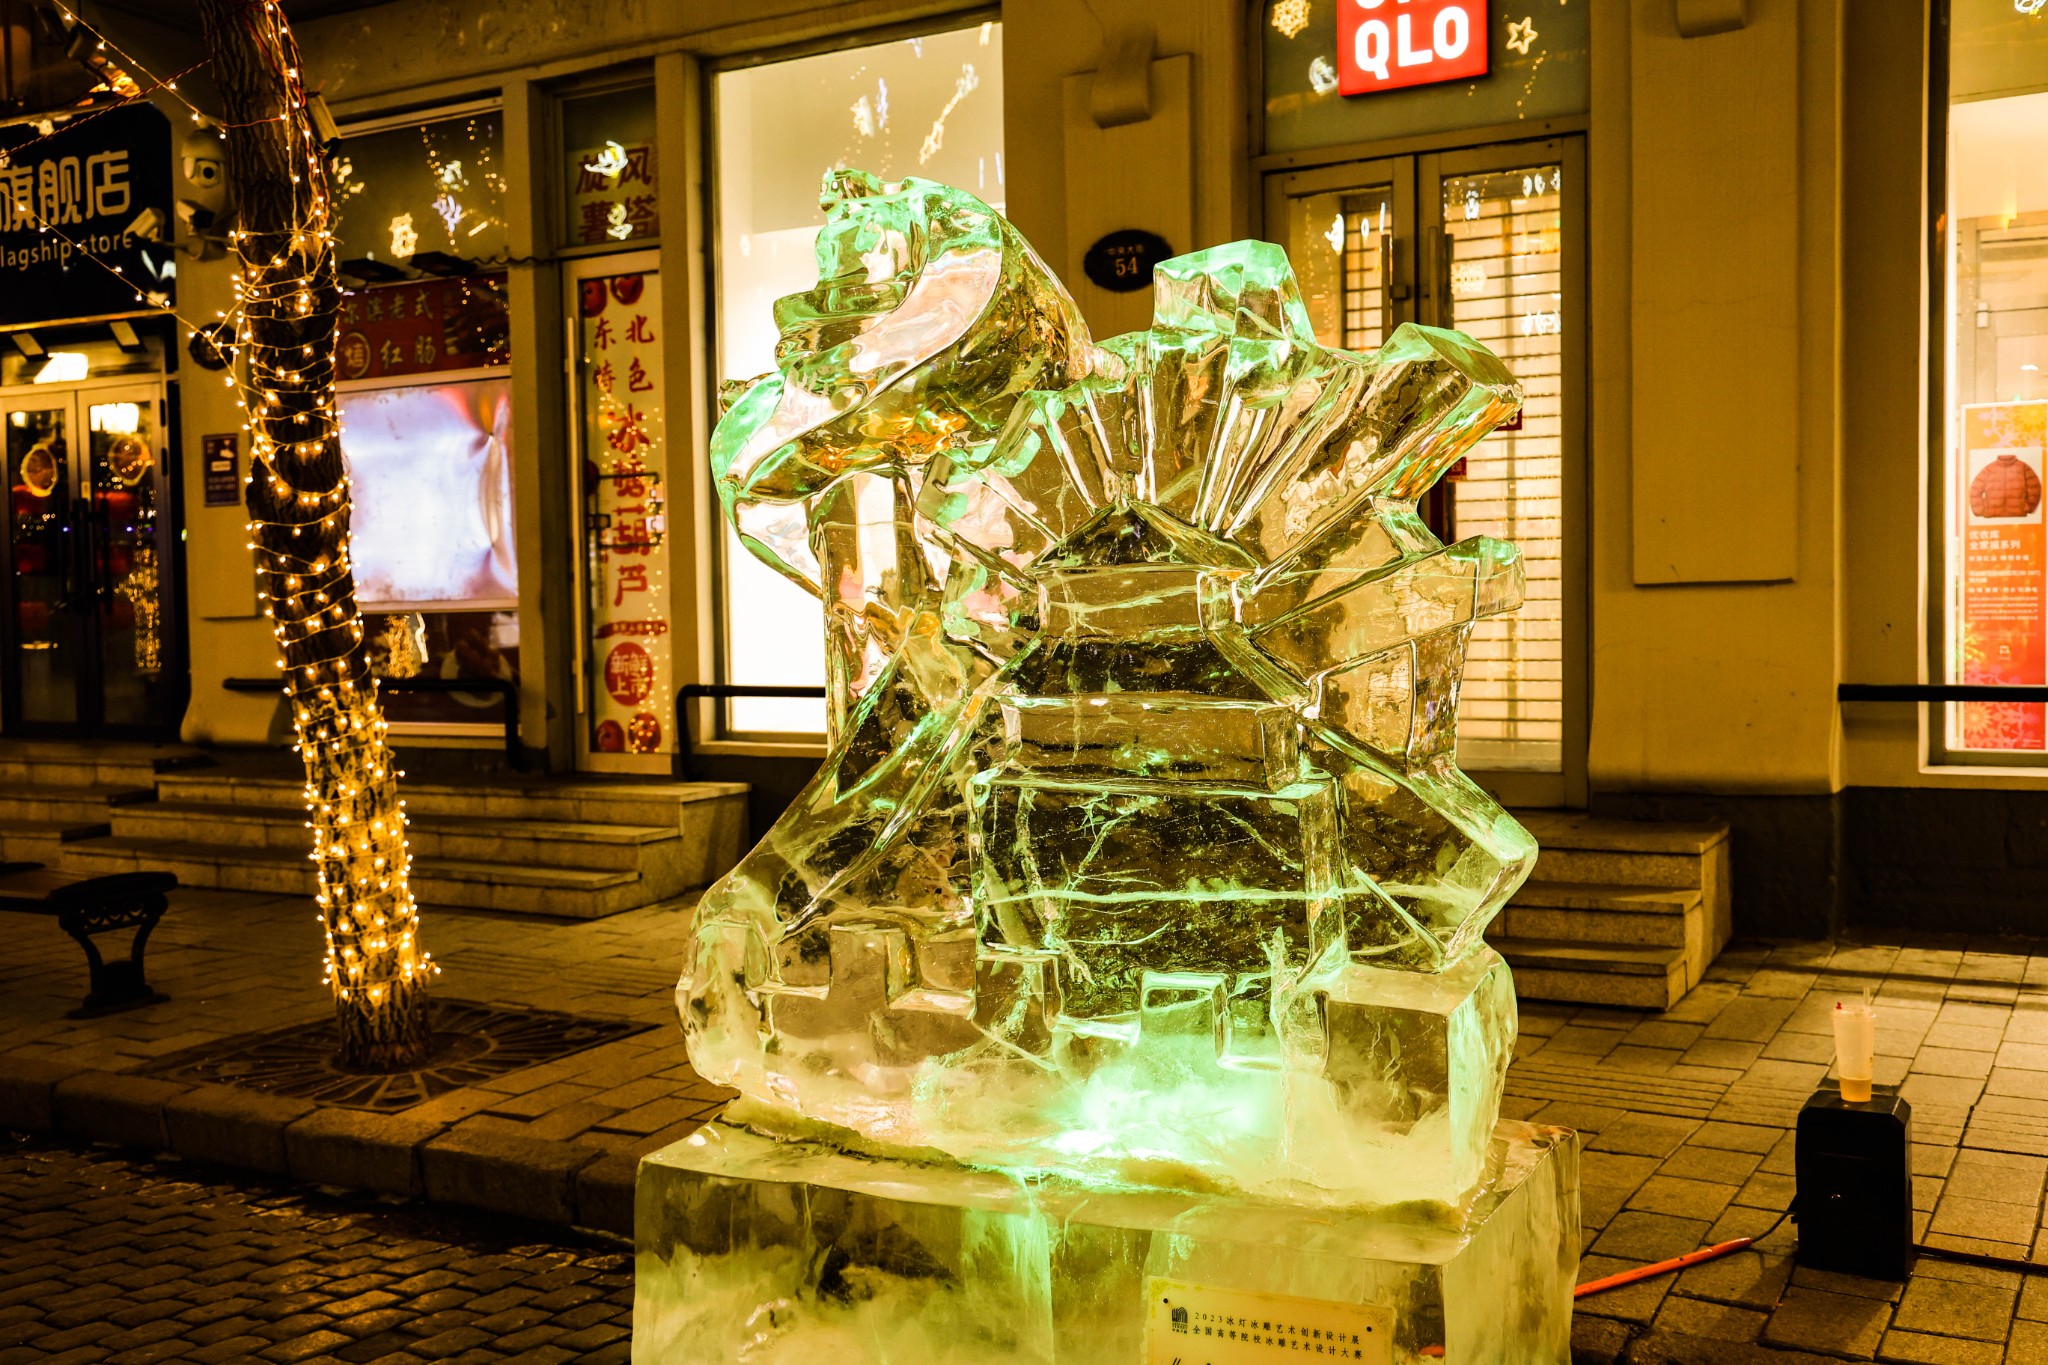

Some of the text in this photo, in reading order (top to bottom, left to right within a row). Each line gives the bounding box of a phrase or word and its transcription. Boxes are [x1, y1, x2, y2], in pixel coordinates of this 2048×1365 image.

[1355, 6, 1469, 80] QLO
[0, 150, 131, 233] 旗舰店
[80, 232, 133, 256] store
[1115, 256, 1139, 276] 54
[593, 313, 656, 351] 东北
[592, 356, 654, 394] 特色
